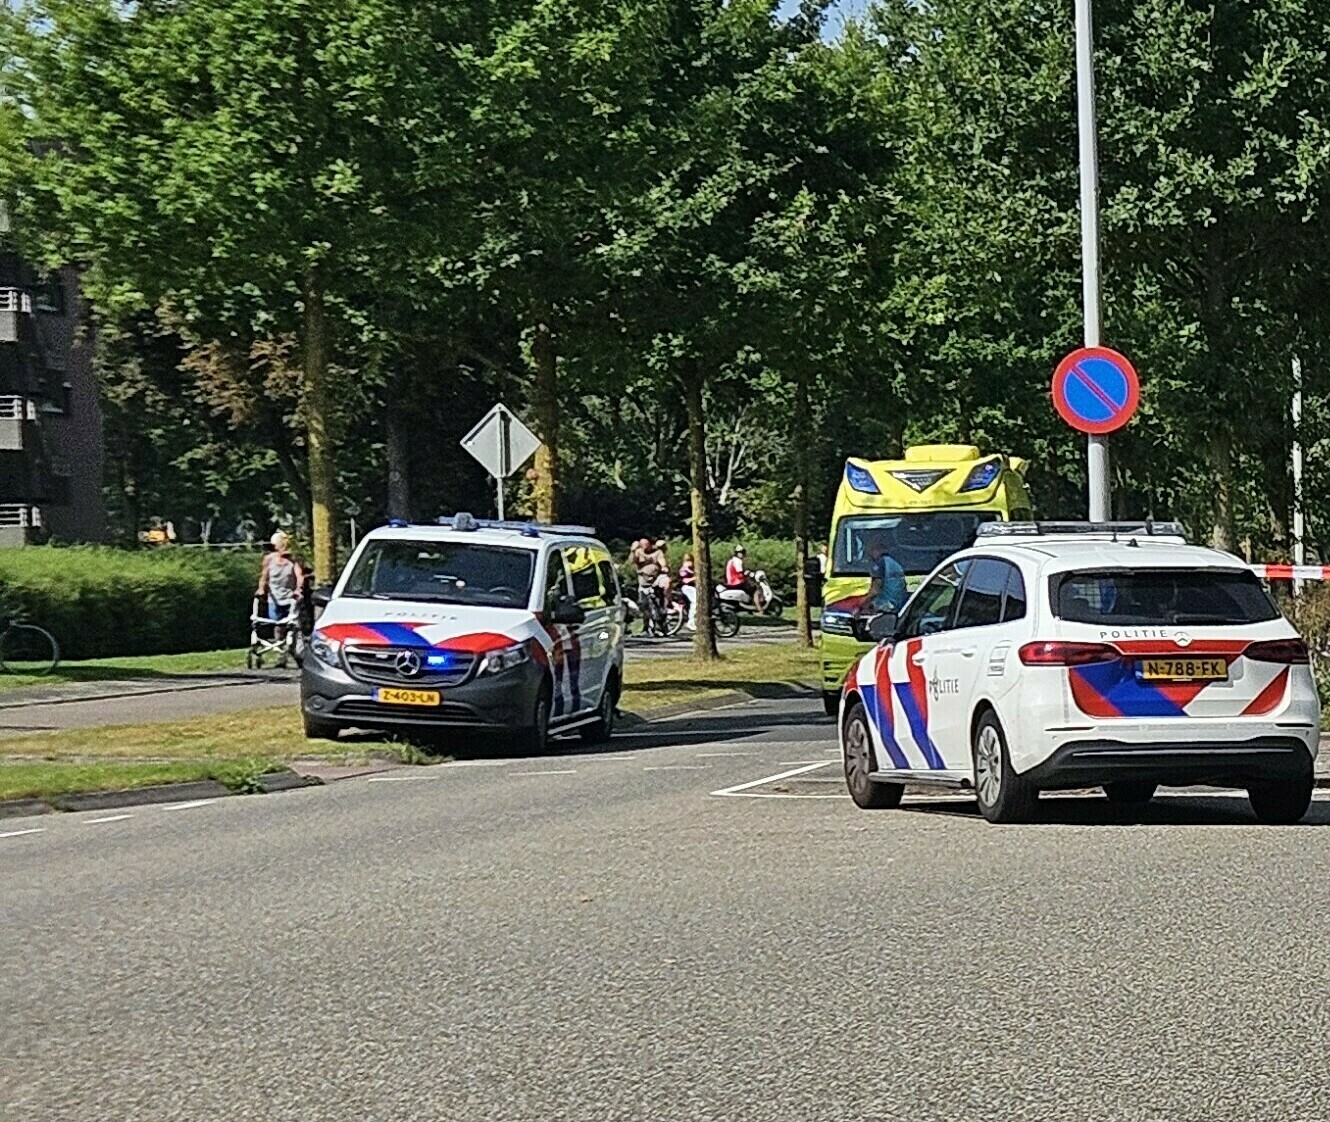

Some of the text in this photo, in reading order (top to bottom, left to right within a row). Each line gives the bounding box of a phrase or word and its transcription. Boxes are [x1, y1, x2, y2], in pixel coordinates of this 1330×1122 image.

[1100, 629, 1168, 639] POLITIE
[1147, 661, 1221, 676] N-788-FK
[383, 689, 436, 703] Z-403-LN
